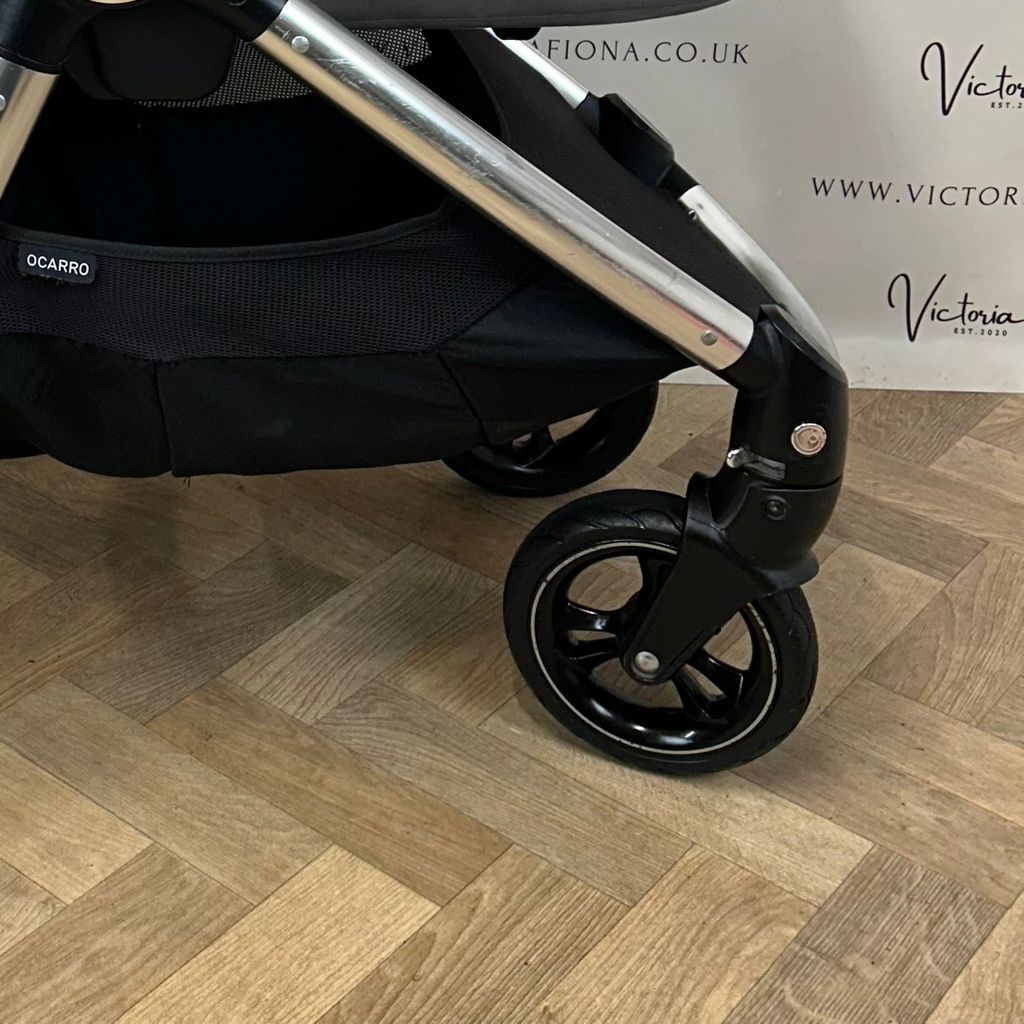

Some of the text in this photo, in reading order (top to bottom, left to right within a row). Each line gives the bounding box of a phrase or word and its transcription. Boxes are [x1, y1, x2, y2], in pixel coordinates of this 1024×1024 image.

[27, 254, 89, 276] OCARRO
[888, 273, 1024, 342] Victoria
[953, 328, 1008, 336] EST.2020
